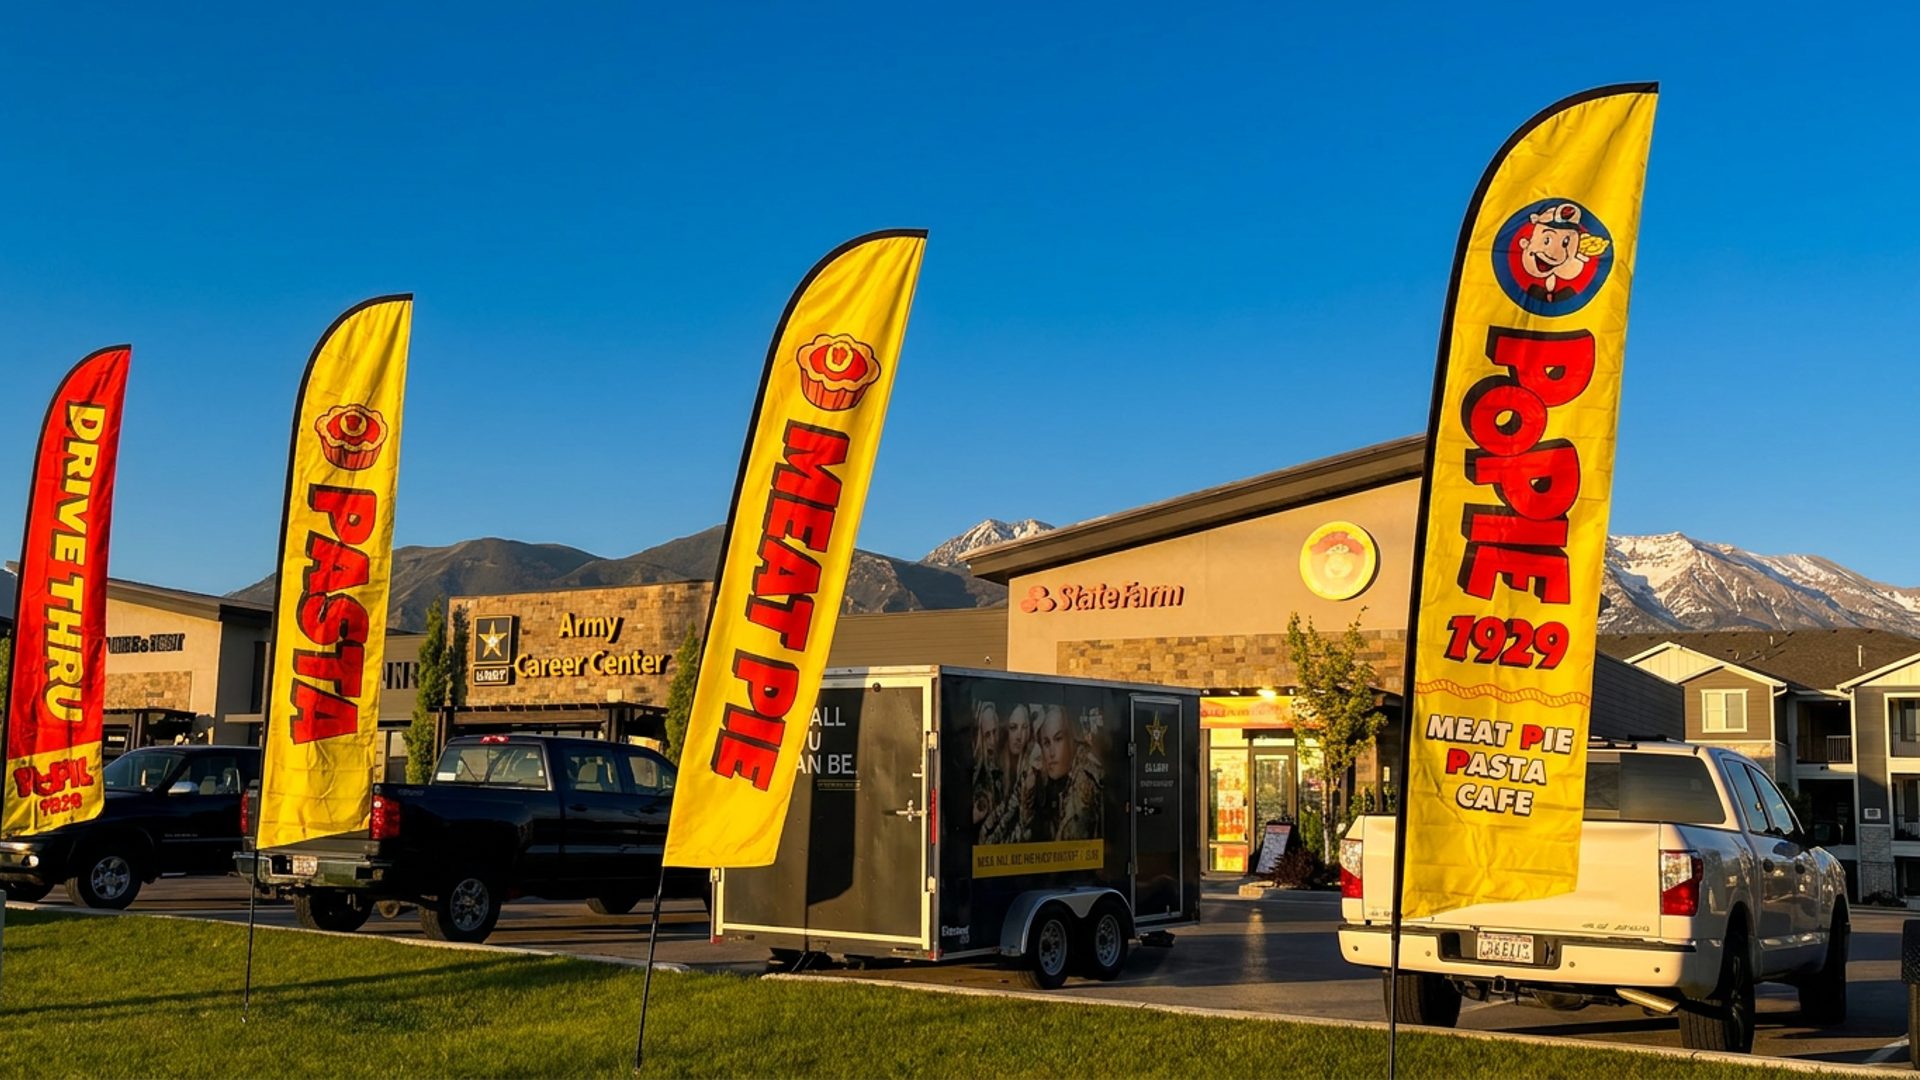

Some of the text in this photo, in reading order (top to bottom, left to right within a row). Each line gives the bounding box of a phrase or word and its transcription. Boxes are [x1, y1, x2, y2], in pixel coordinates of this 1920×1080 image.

[1457, 325, 1596, 604] POPIE
[44, 402, 105, 722] DRIVE THRU
[290, 484, 377, 745] PASTA
[711, 419, 850, 792] MEAT PIE
[559, 612, 622, 643] Army
[1443, 616, 1570, 669] 1929
[514, 652, 586, 678] Career
[589, 650, 667, 675] Center
[809, 706, 846, 726] ALL
[1426, 714, 1574, 754] MEAT PIE
[1446, 748, 1546, 785] PASTA
[1456, 783, 1534, 816] CAFE
